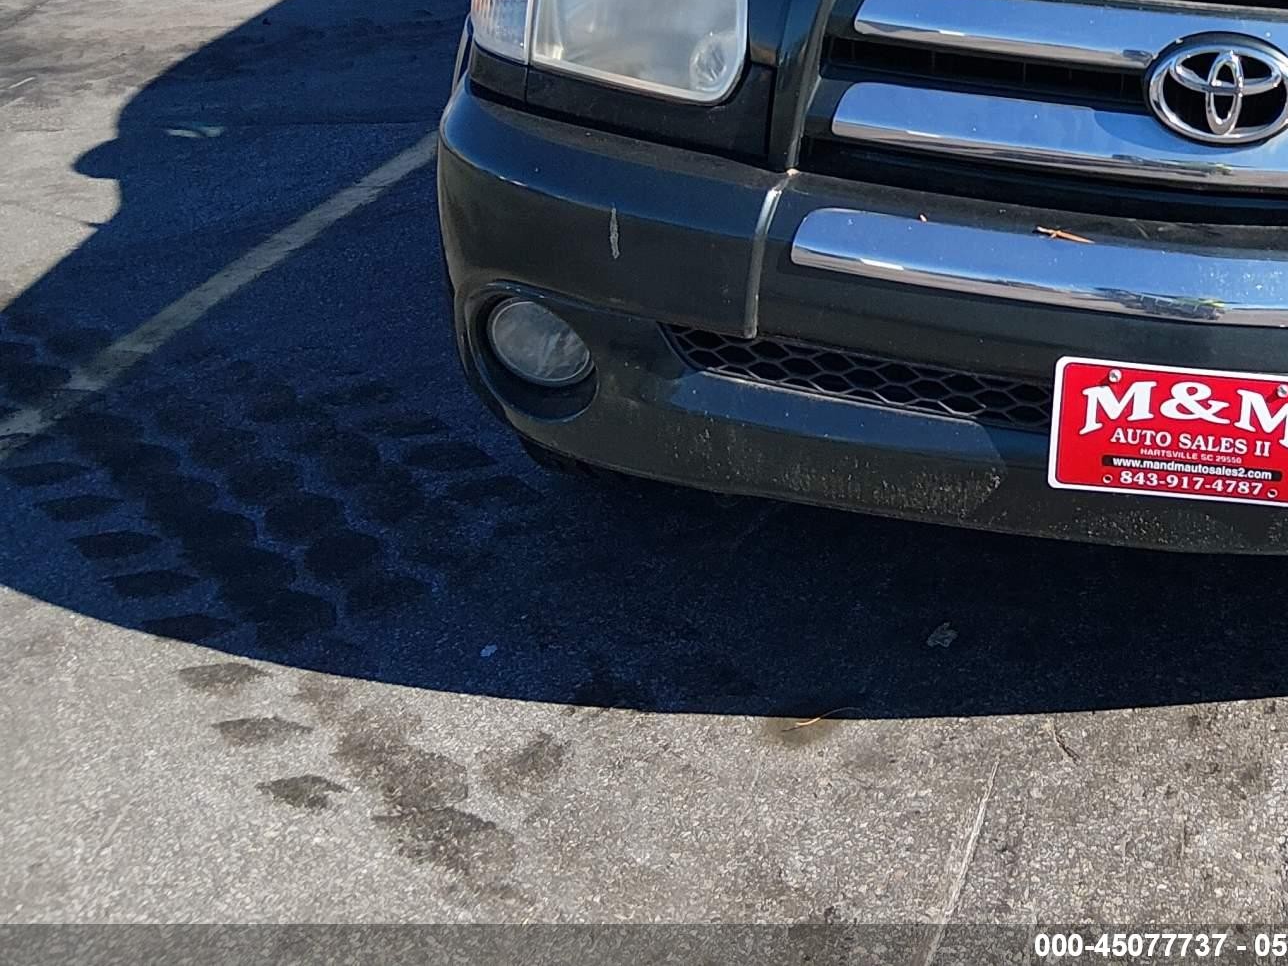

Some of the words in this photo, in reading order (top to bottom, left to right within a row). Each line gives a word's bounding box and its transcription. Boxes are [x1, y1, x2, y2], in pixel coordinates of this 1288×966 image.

[1110, 426, 1172, 447] AUTO
[1178, 433, 1248, 456] SALES
[1254, 441, 1271, 458] II
[1112, 456, 1272, 481] www.mandmautosales2.com
[1139, 448, 1198, 461] HARTSVILLE
[1201, 453, 1214, 463] SC
[1215, 455, 1242, 465] 29550
[1119, 470, 1264, 497] 843-917-4787
